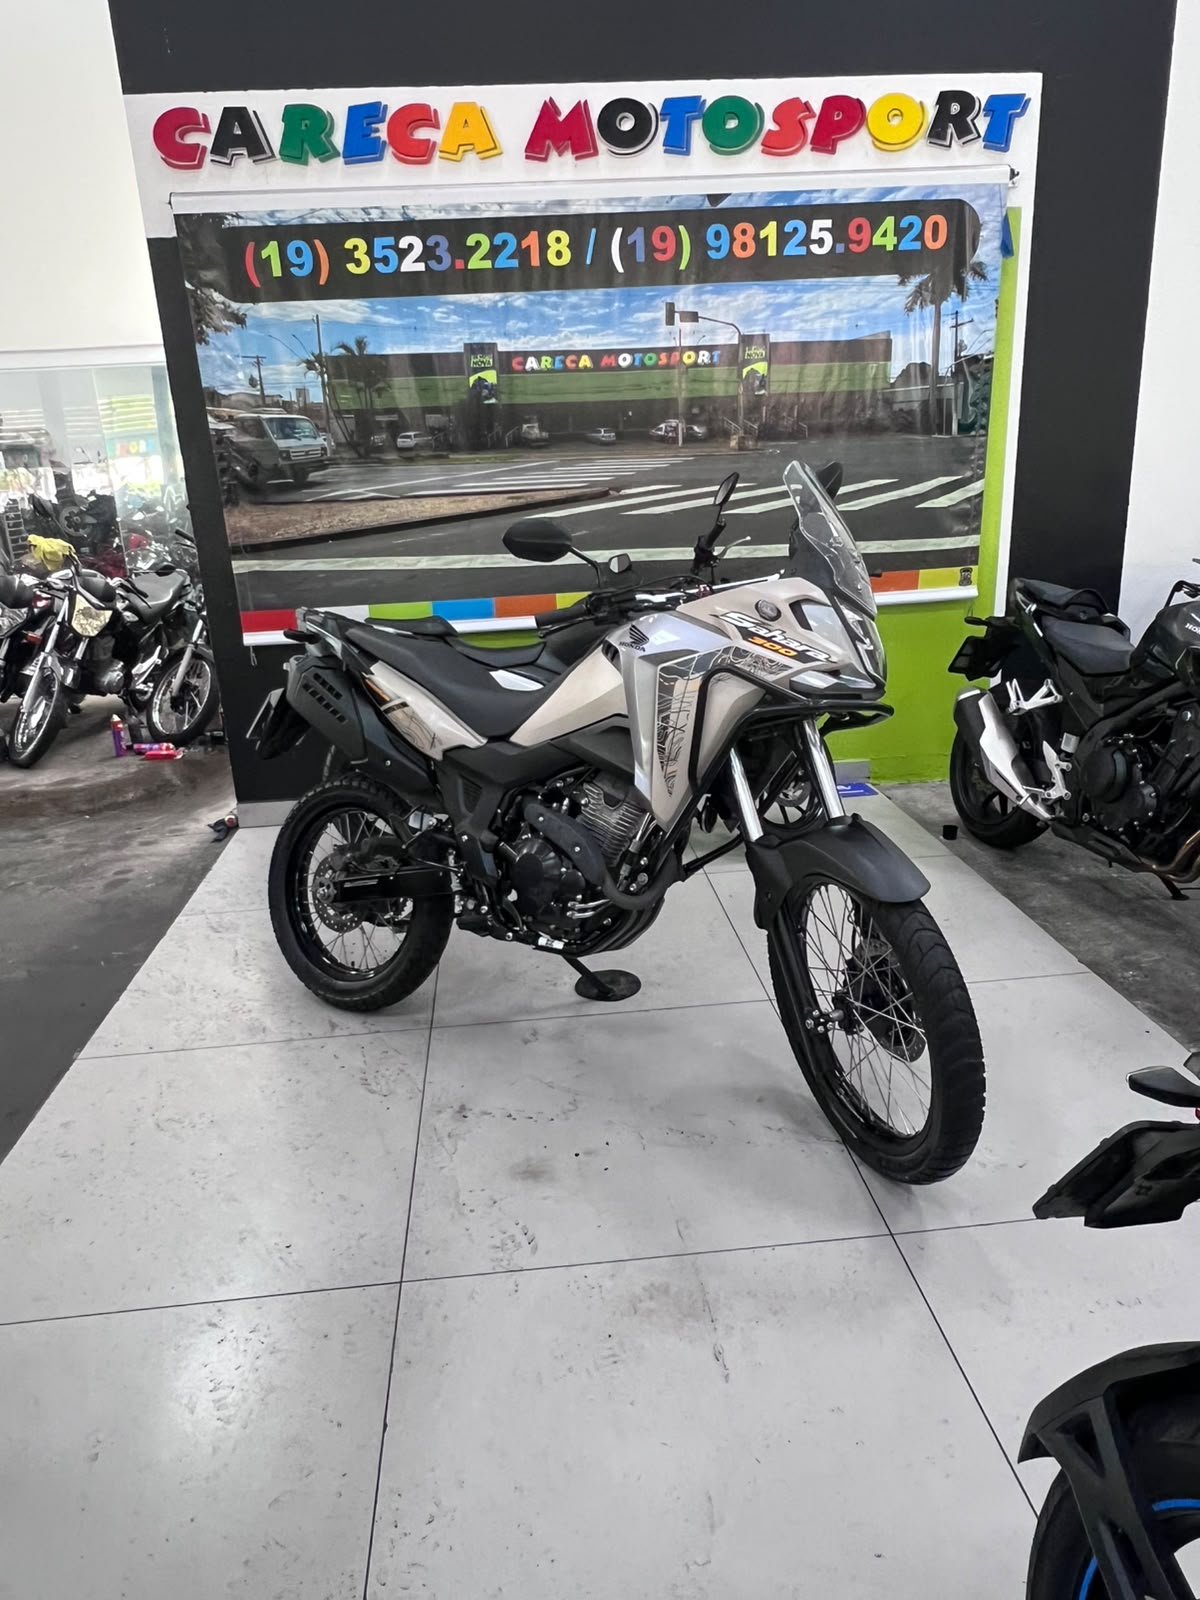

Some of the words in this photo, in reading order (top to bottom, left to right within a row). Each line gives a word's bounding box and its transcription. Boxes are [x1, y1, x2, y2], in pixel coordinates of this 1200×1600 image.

[153, 101, 503, 170] CARECA
[523, 90, 1031, 163] MOTOSPORT
[244, 239, 329, 287] (19)
[344, 230, 571, 275] 3523.2218
[610, 225, 692, 273] (19)
[706, 214, 948, 261] 98125.9420
[511, 354, 593, 371] CARECA
[600, 350, 721, 368] MOTOSPORT
[619, 641, 646, 652] HONDA
[719, 611, 831, 663] Sahara
[749, 636, 798, 657] 300
